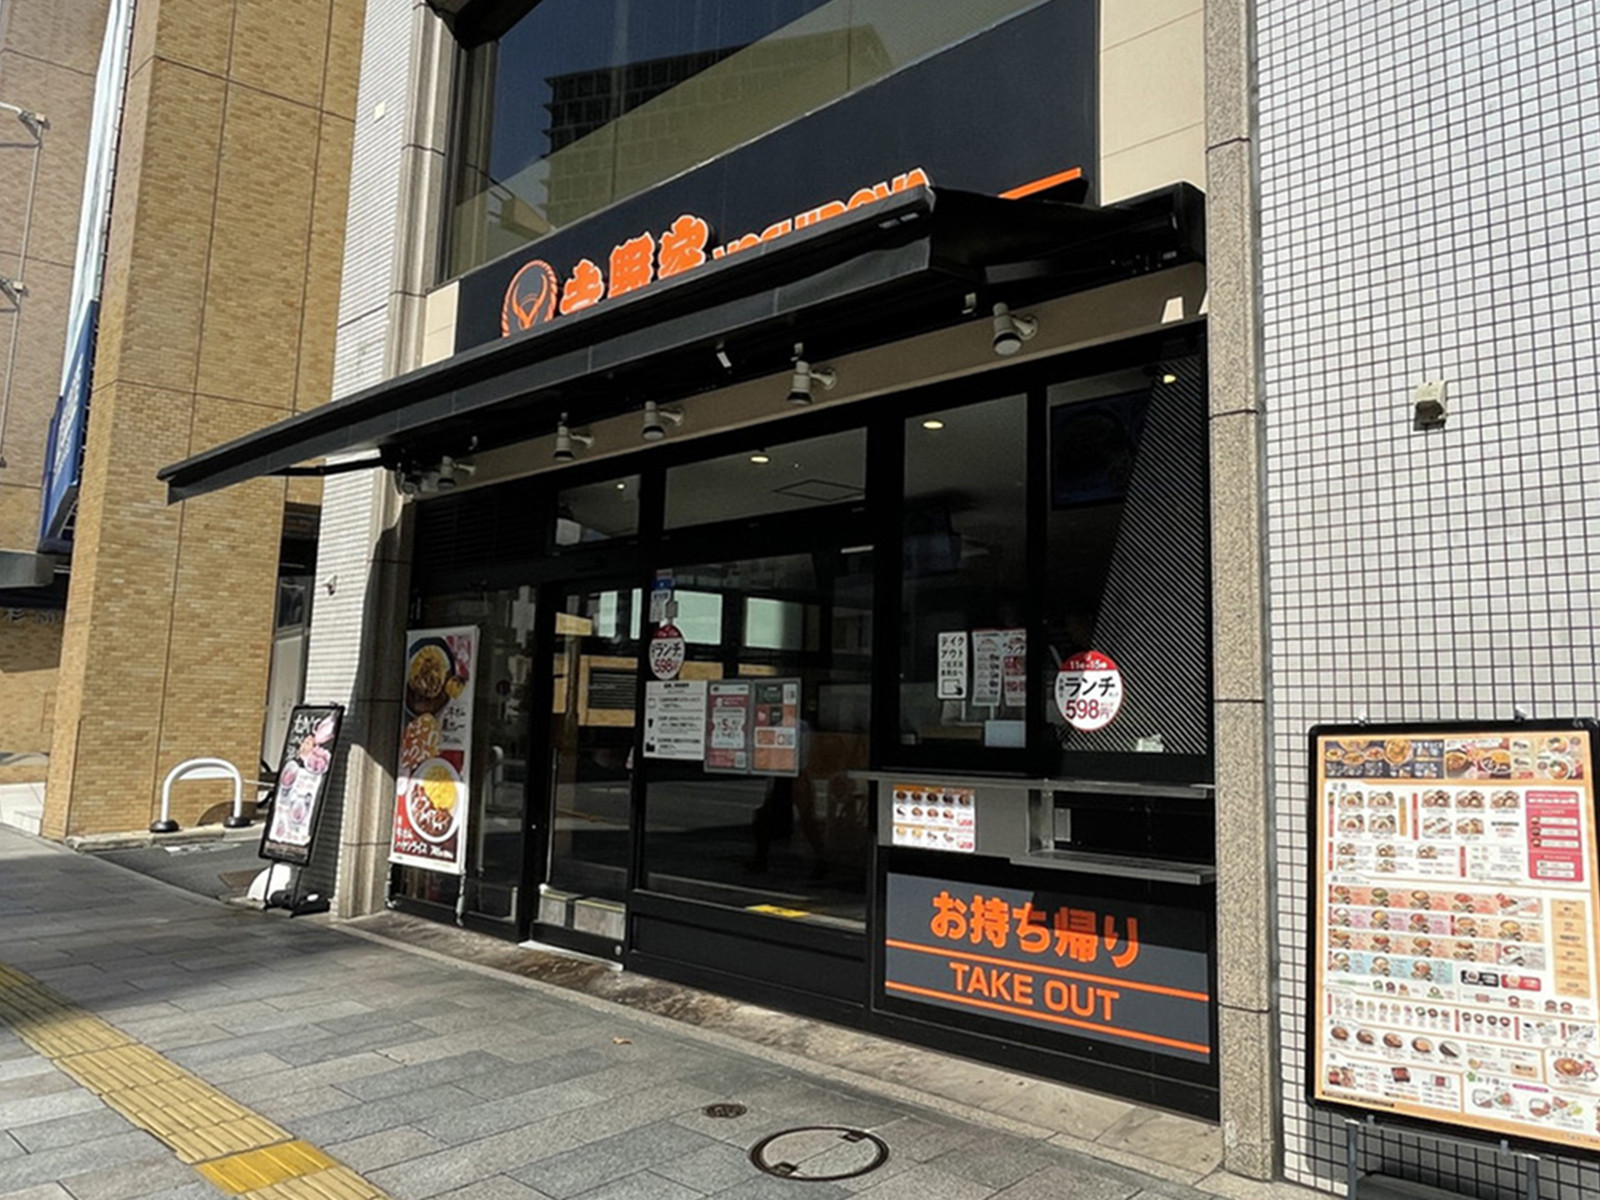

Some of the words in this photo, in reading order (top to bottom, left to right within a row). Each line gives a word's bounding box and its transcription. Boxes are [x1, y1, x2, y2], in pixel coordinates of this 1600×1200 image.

[1064, 676, 1116, 697] ランチ
[930, 891, 1139, 968] お持ち帰り
[949, 961, 1033, 1005] TAKE
[1044, 979, 1120, 1021] OUT
